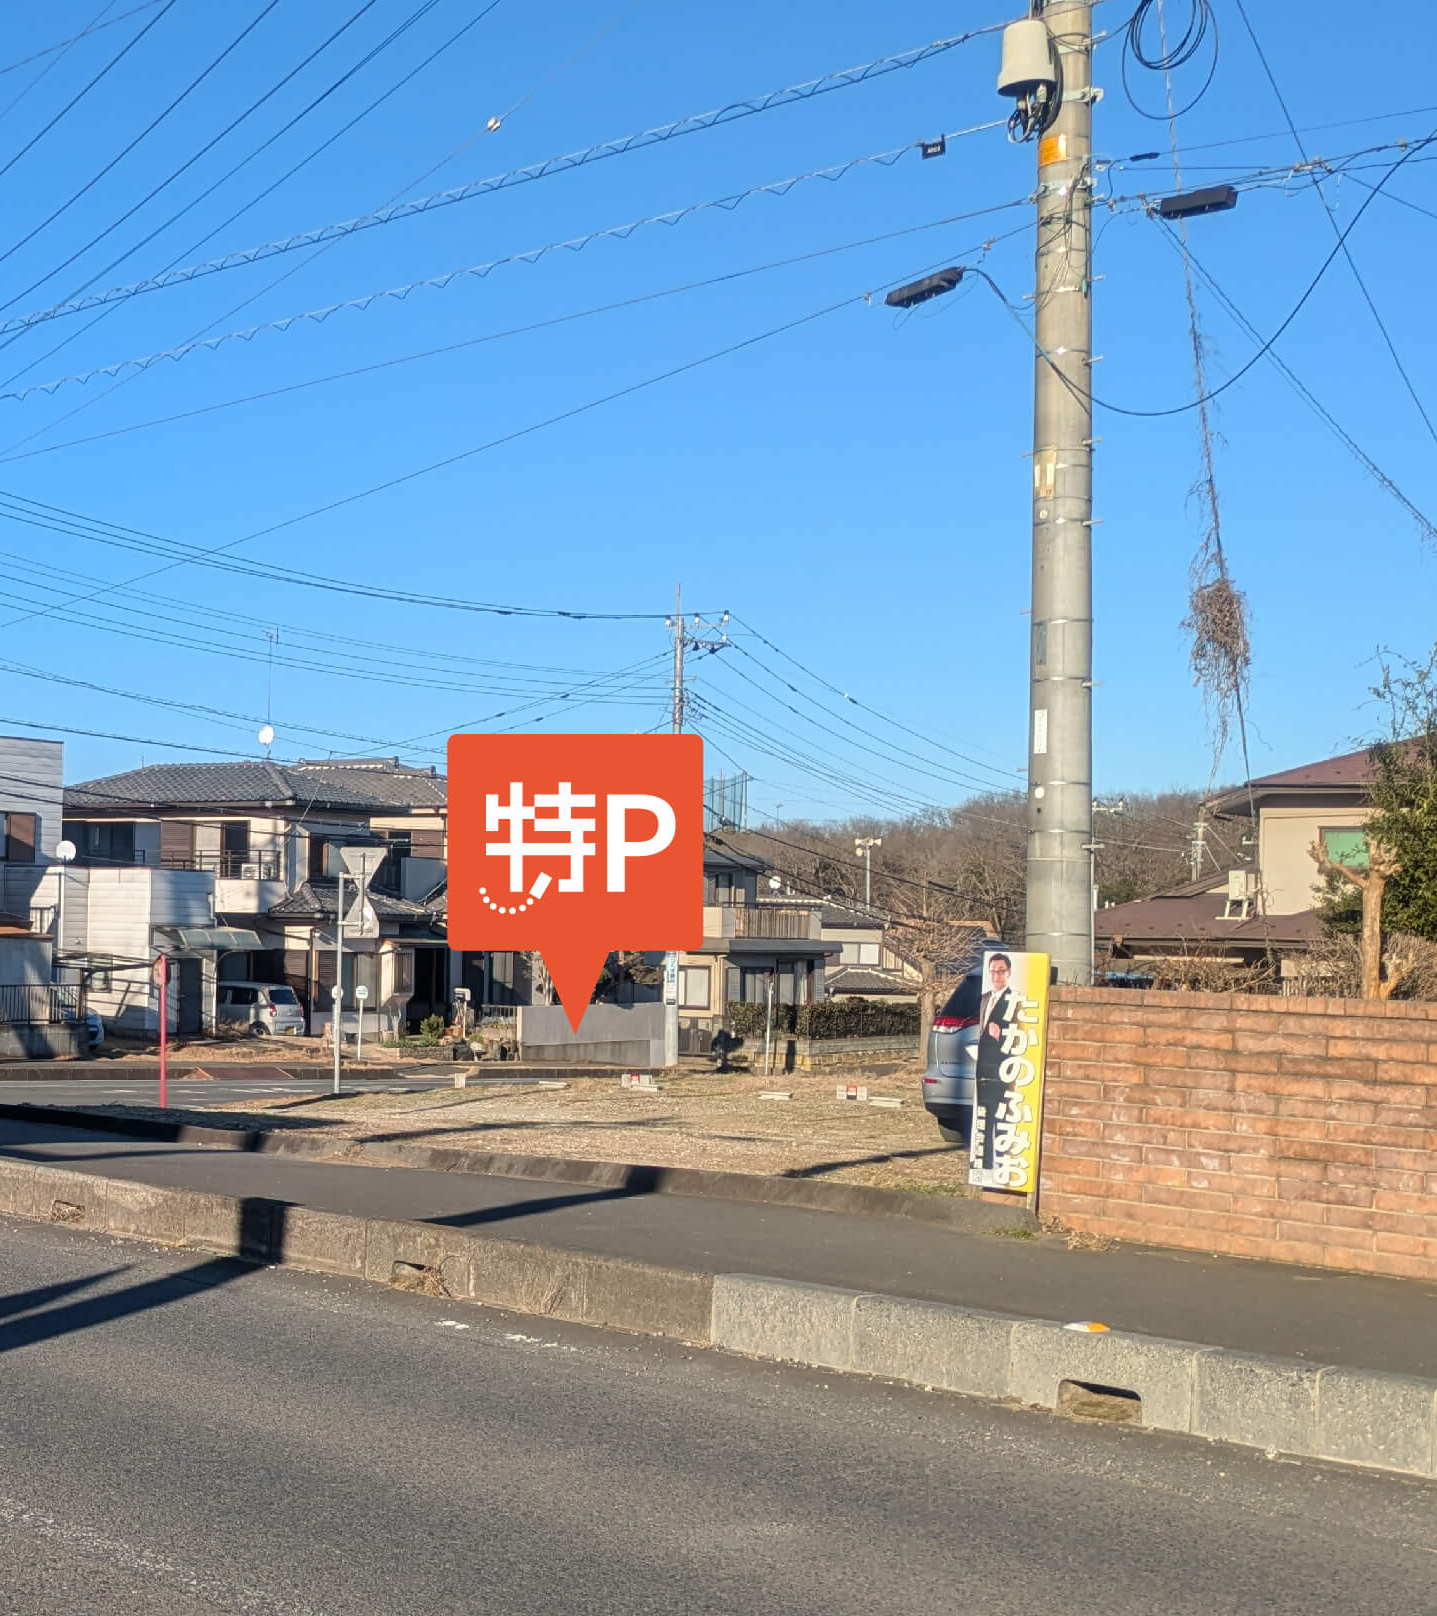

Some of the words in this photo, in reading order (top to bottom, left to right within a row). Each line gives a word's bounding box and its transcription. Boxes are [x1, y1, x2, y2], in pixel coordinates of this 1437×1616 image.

[993, 990, 1039, 1188] たかのふみお
